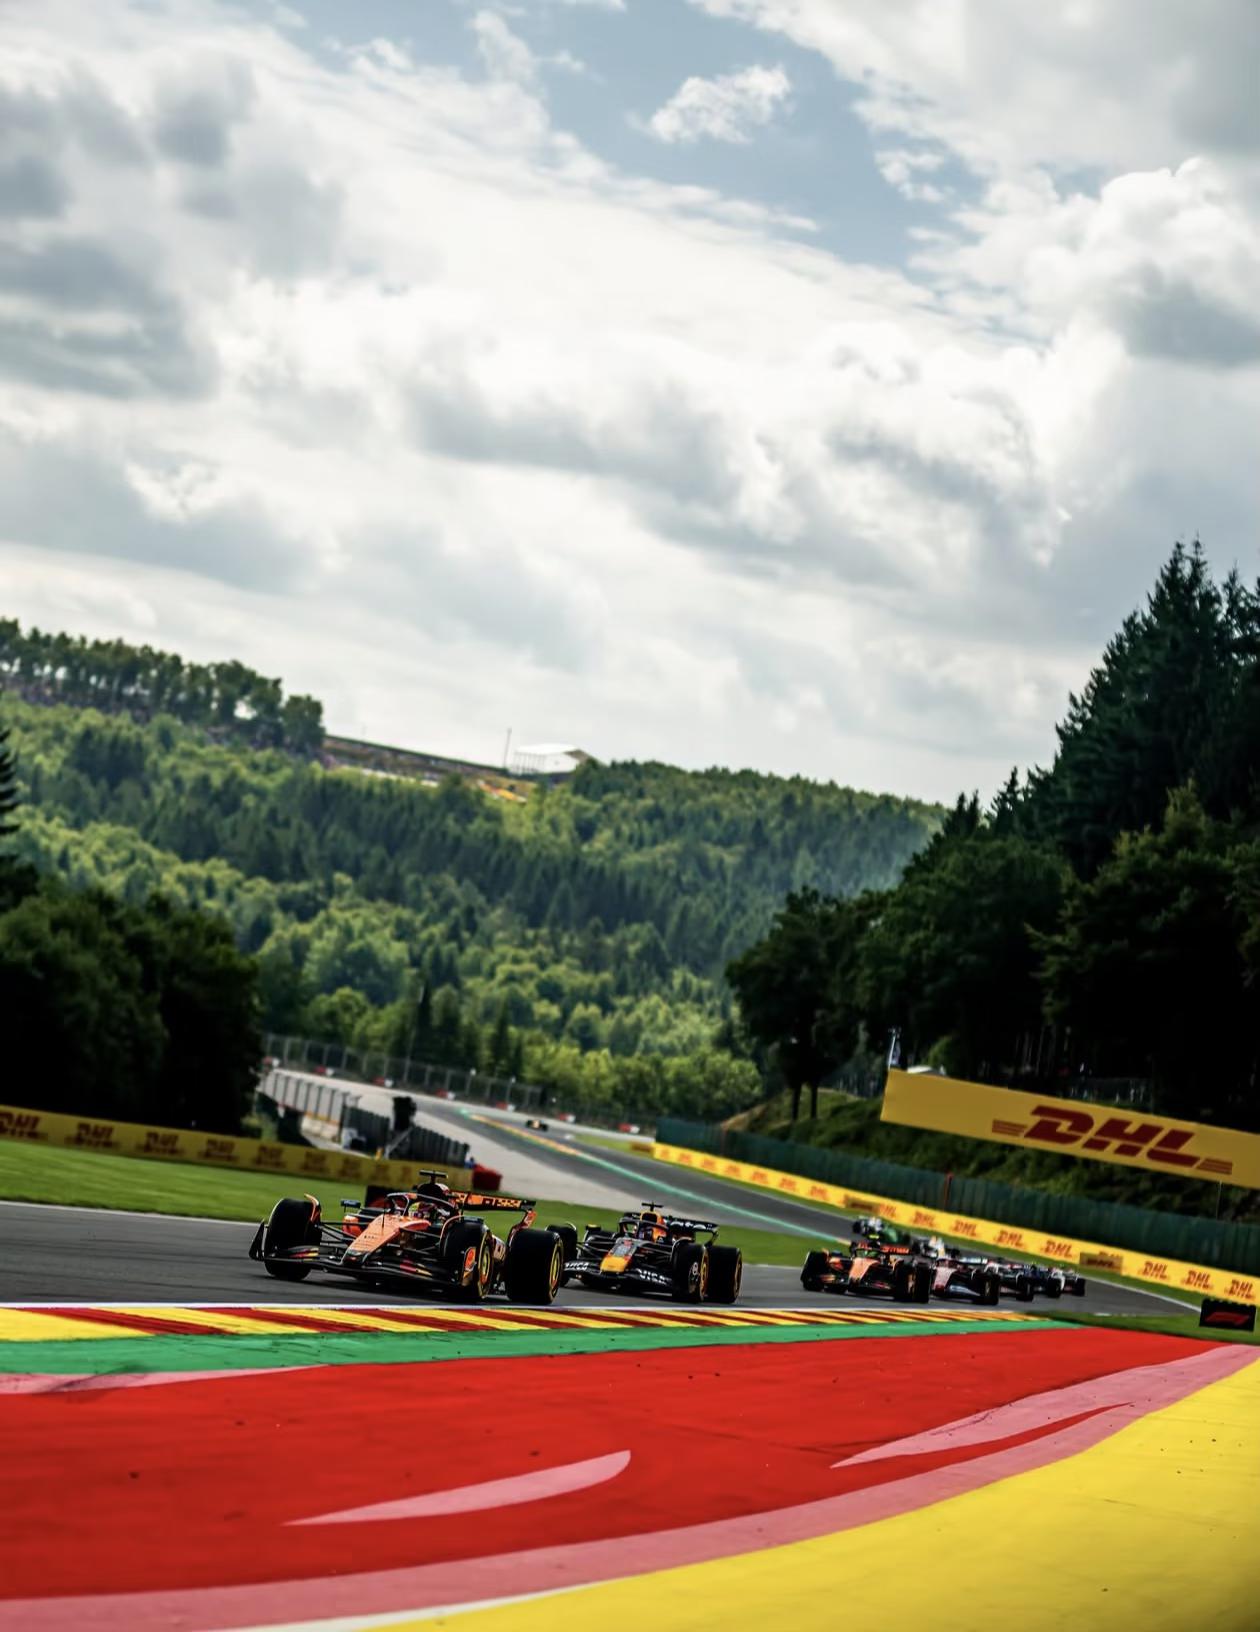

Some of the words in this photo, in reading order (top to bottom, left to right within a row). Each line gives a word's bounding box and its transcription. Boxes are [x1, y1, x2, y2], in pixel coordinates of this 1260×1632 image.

[1023, 1105, 1200, 1168] DHL
[952, 1219, 978, 1238] DHL
[997, 1229, 1024, 1247] DHL
[1045, 1239, 1073, 1258] DHL
[1141, 1260, 1169, 1280] DHL
[1184, 1269, 1211, 1289] DHL
[1229, 1278, 1254, 1299] DHL
